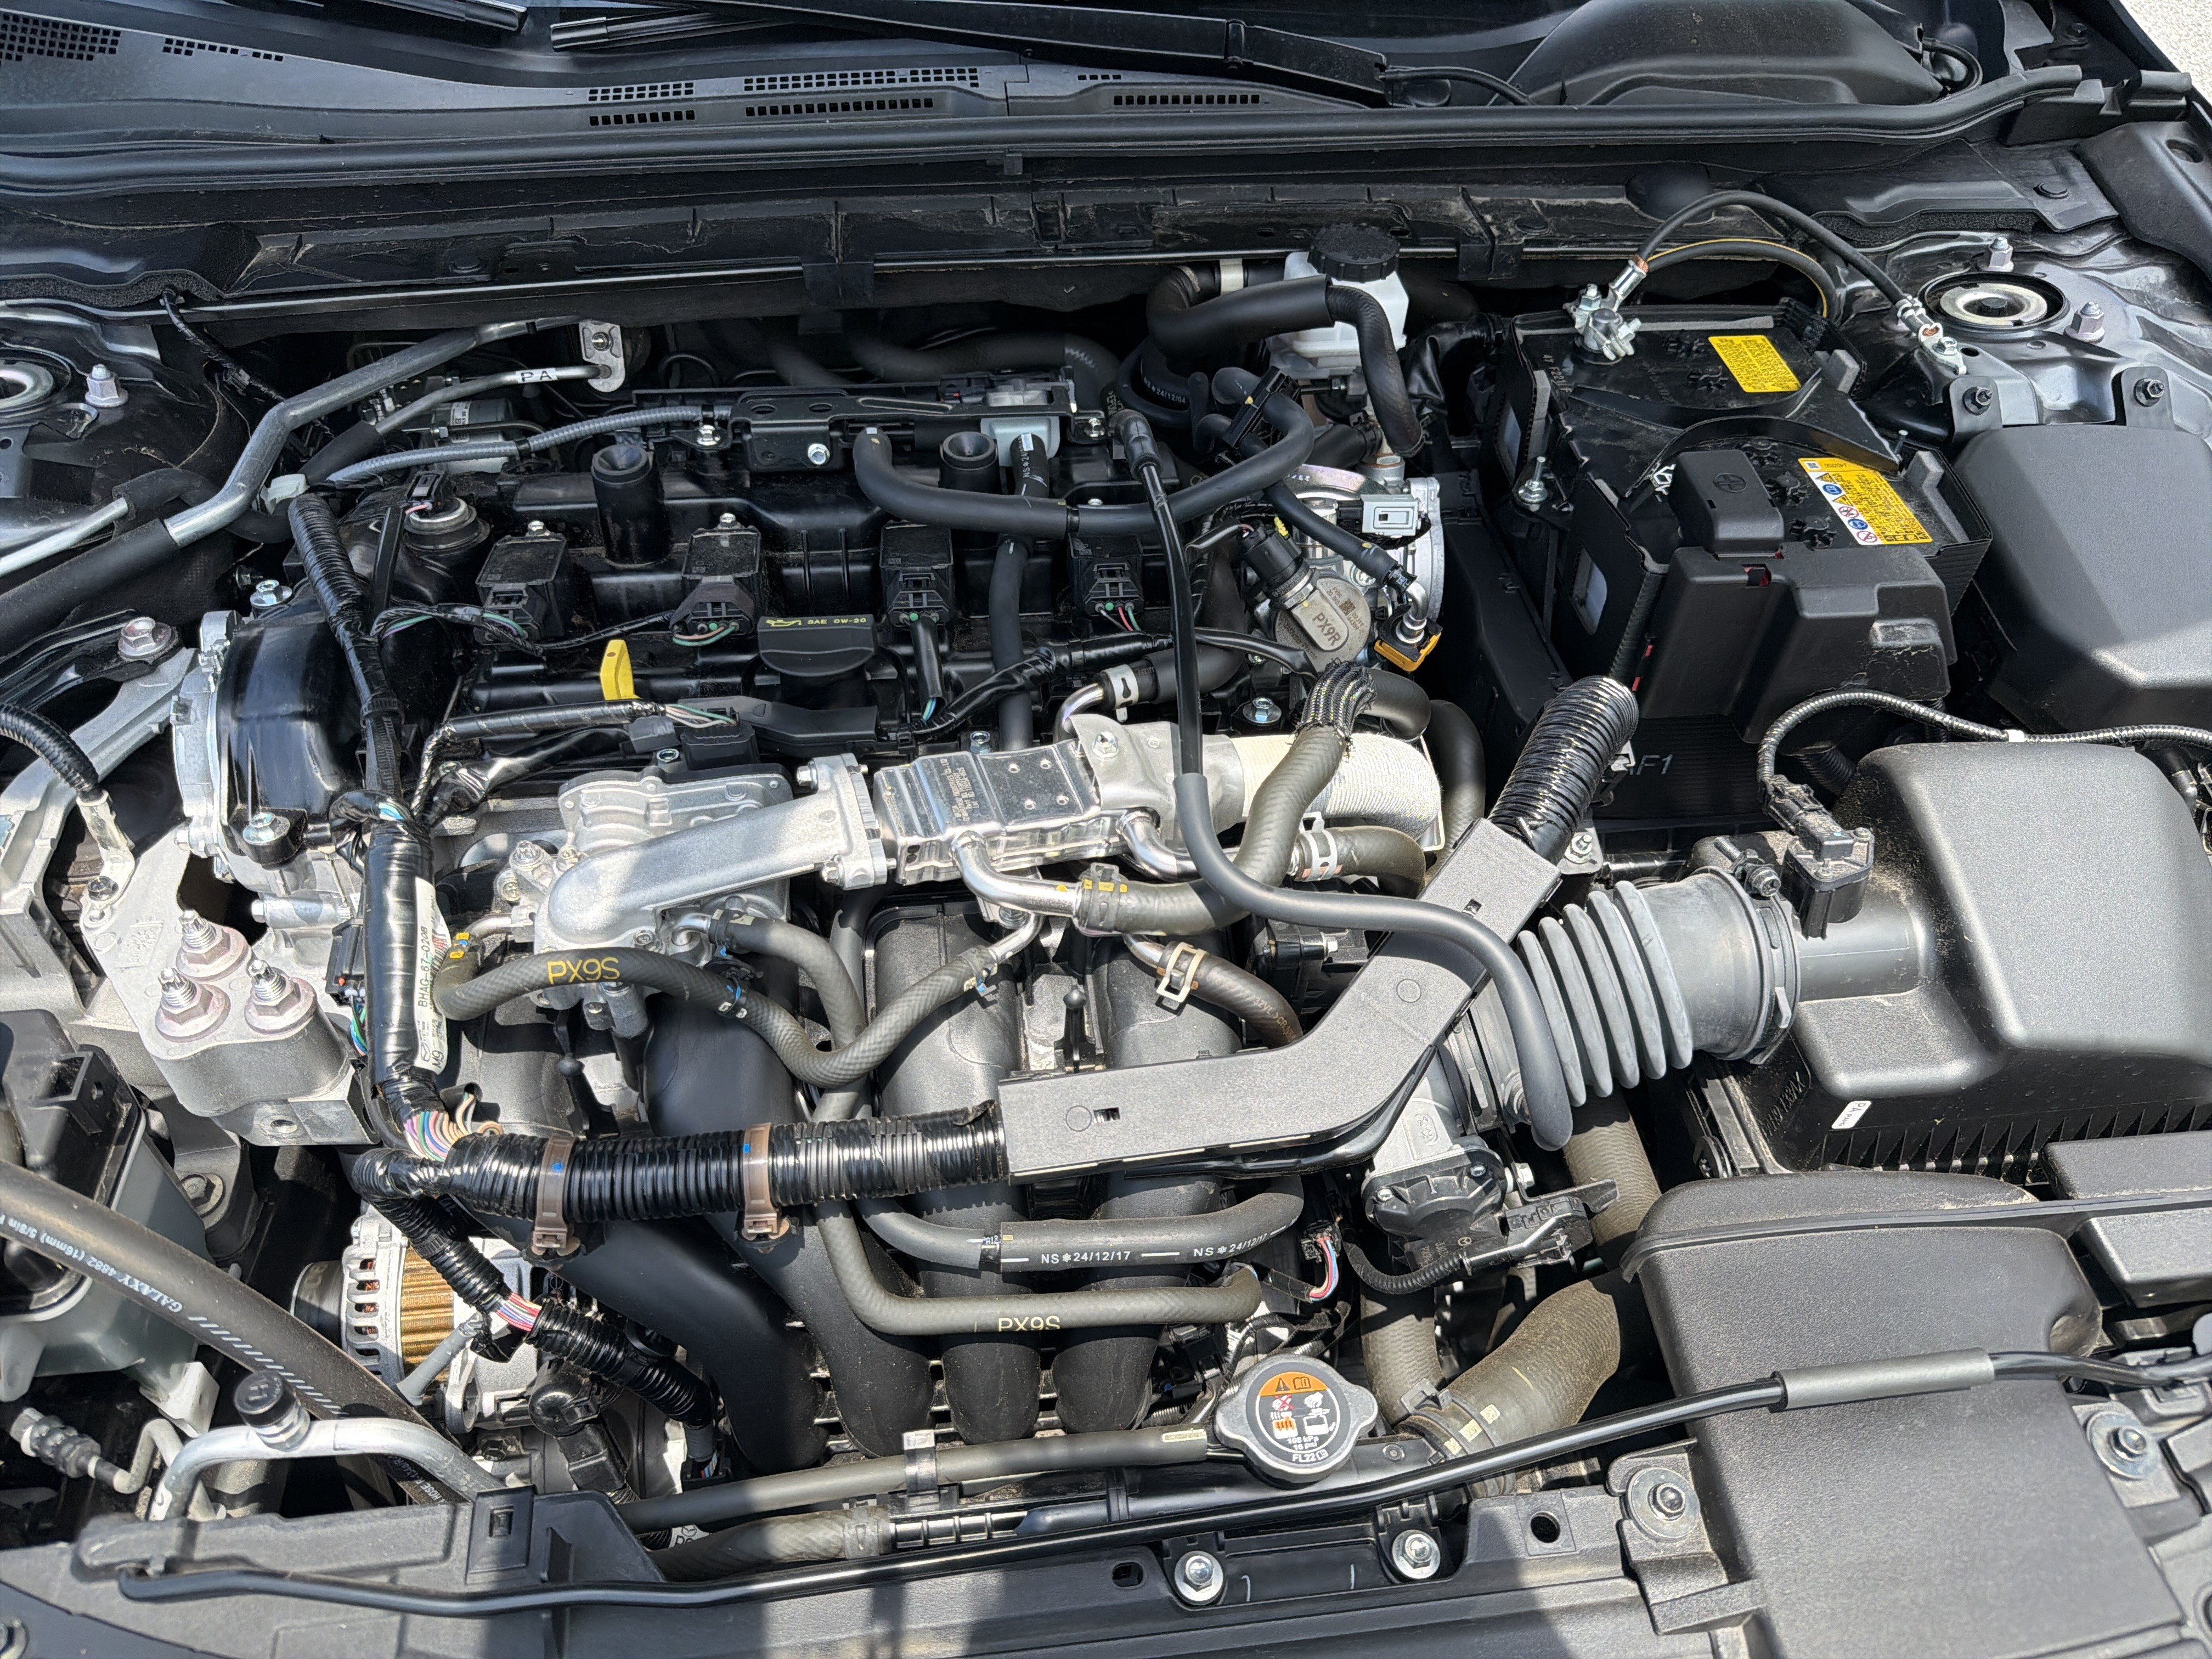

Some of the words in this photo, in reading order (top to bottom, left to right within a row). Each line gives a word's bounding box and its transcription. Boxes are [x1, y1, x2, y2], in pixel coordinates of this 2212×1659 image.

[520, 371, 554, 382] PA
[833, 617, 867, 625] 0W-20
[1316, 612, 1341, 646] PX9R
[1629, 754, 1673, 775] F1
[417, 926, 430, 1007] BHAG-67-020B
[548, 957, 620, 984] PX9S
[431, 1049, 444, 1069] M9
[86, 1254, 115, 1277] 4882
[118, 1274, 182, 1312] GALAXY
[997, 1315, 1061, 1333] PX9S
[1287, 1436, 1302, 1444] 108
[1293, 1453, 1317, 1461] FL22
